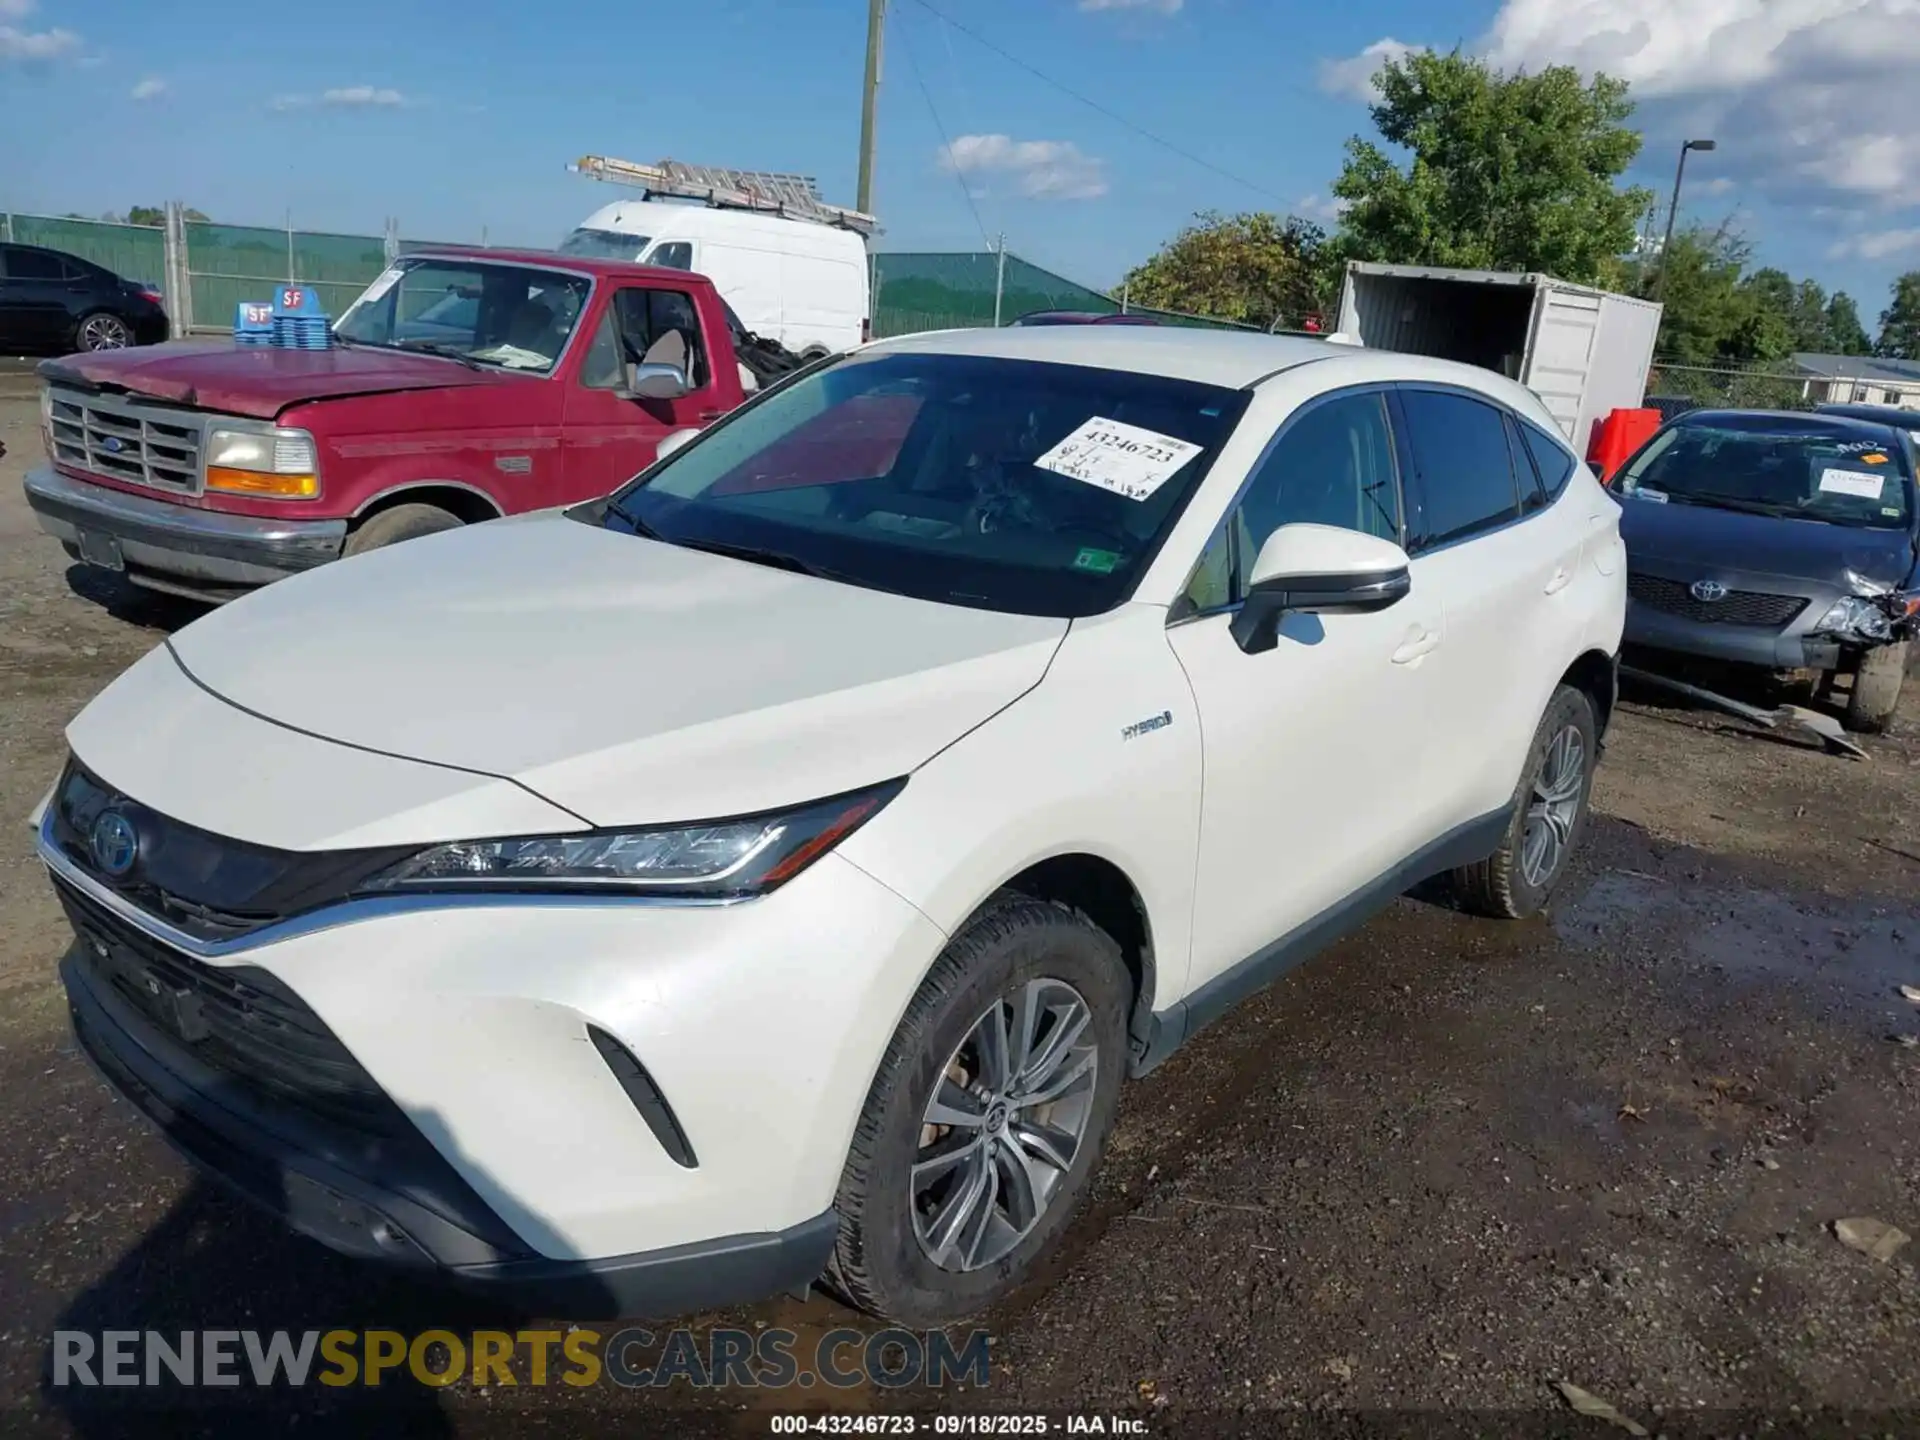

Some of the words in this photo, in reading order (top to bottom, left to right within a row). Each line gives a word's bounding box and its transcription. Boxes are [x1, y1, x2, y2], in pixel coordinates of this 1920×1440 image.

[283, 291, 301, 306] SF
[248, 307, 268, 322] SF
[1084, 431, 1174, 463] 43246723
[1120, 714, 1167, 742] HYBRID
